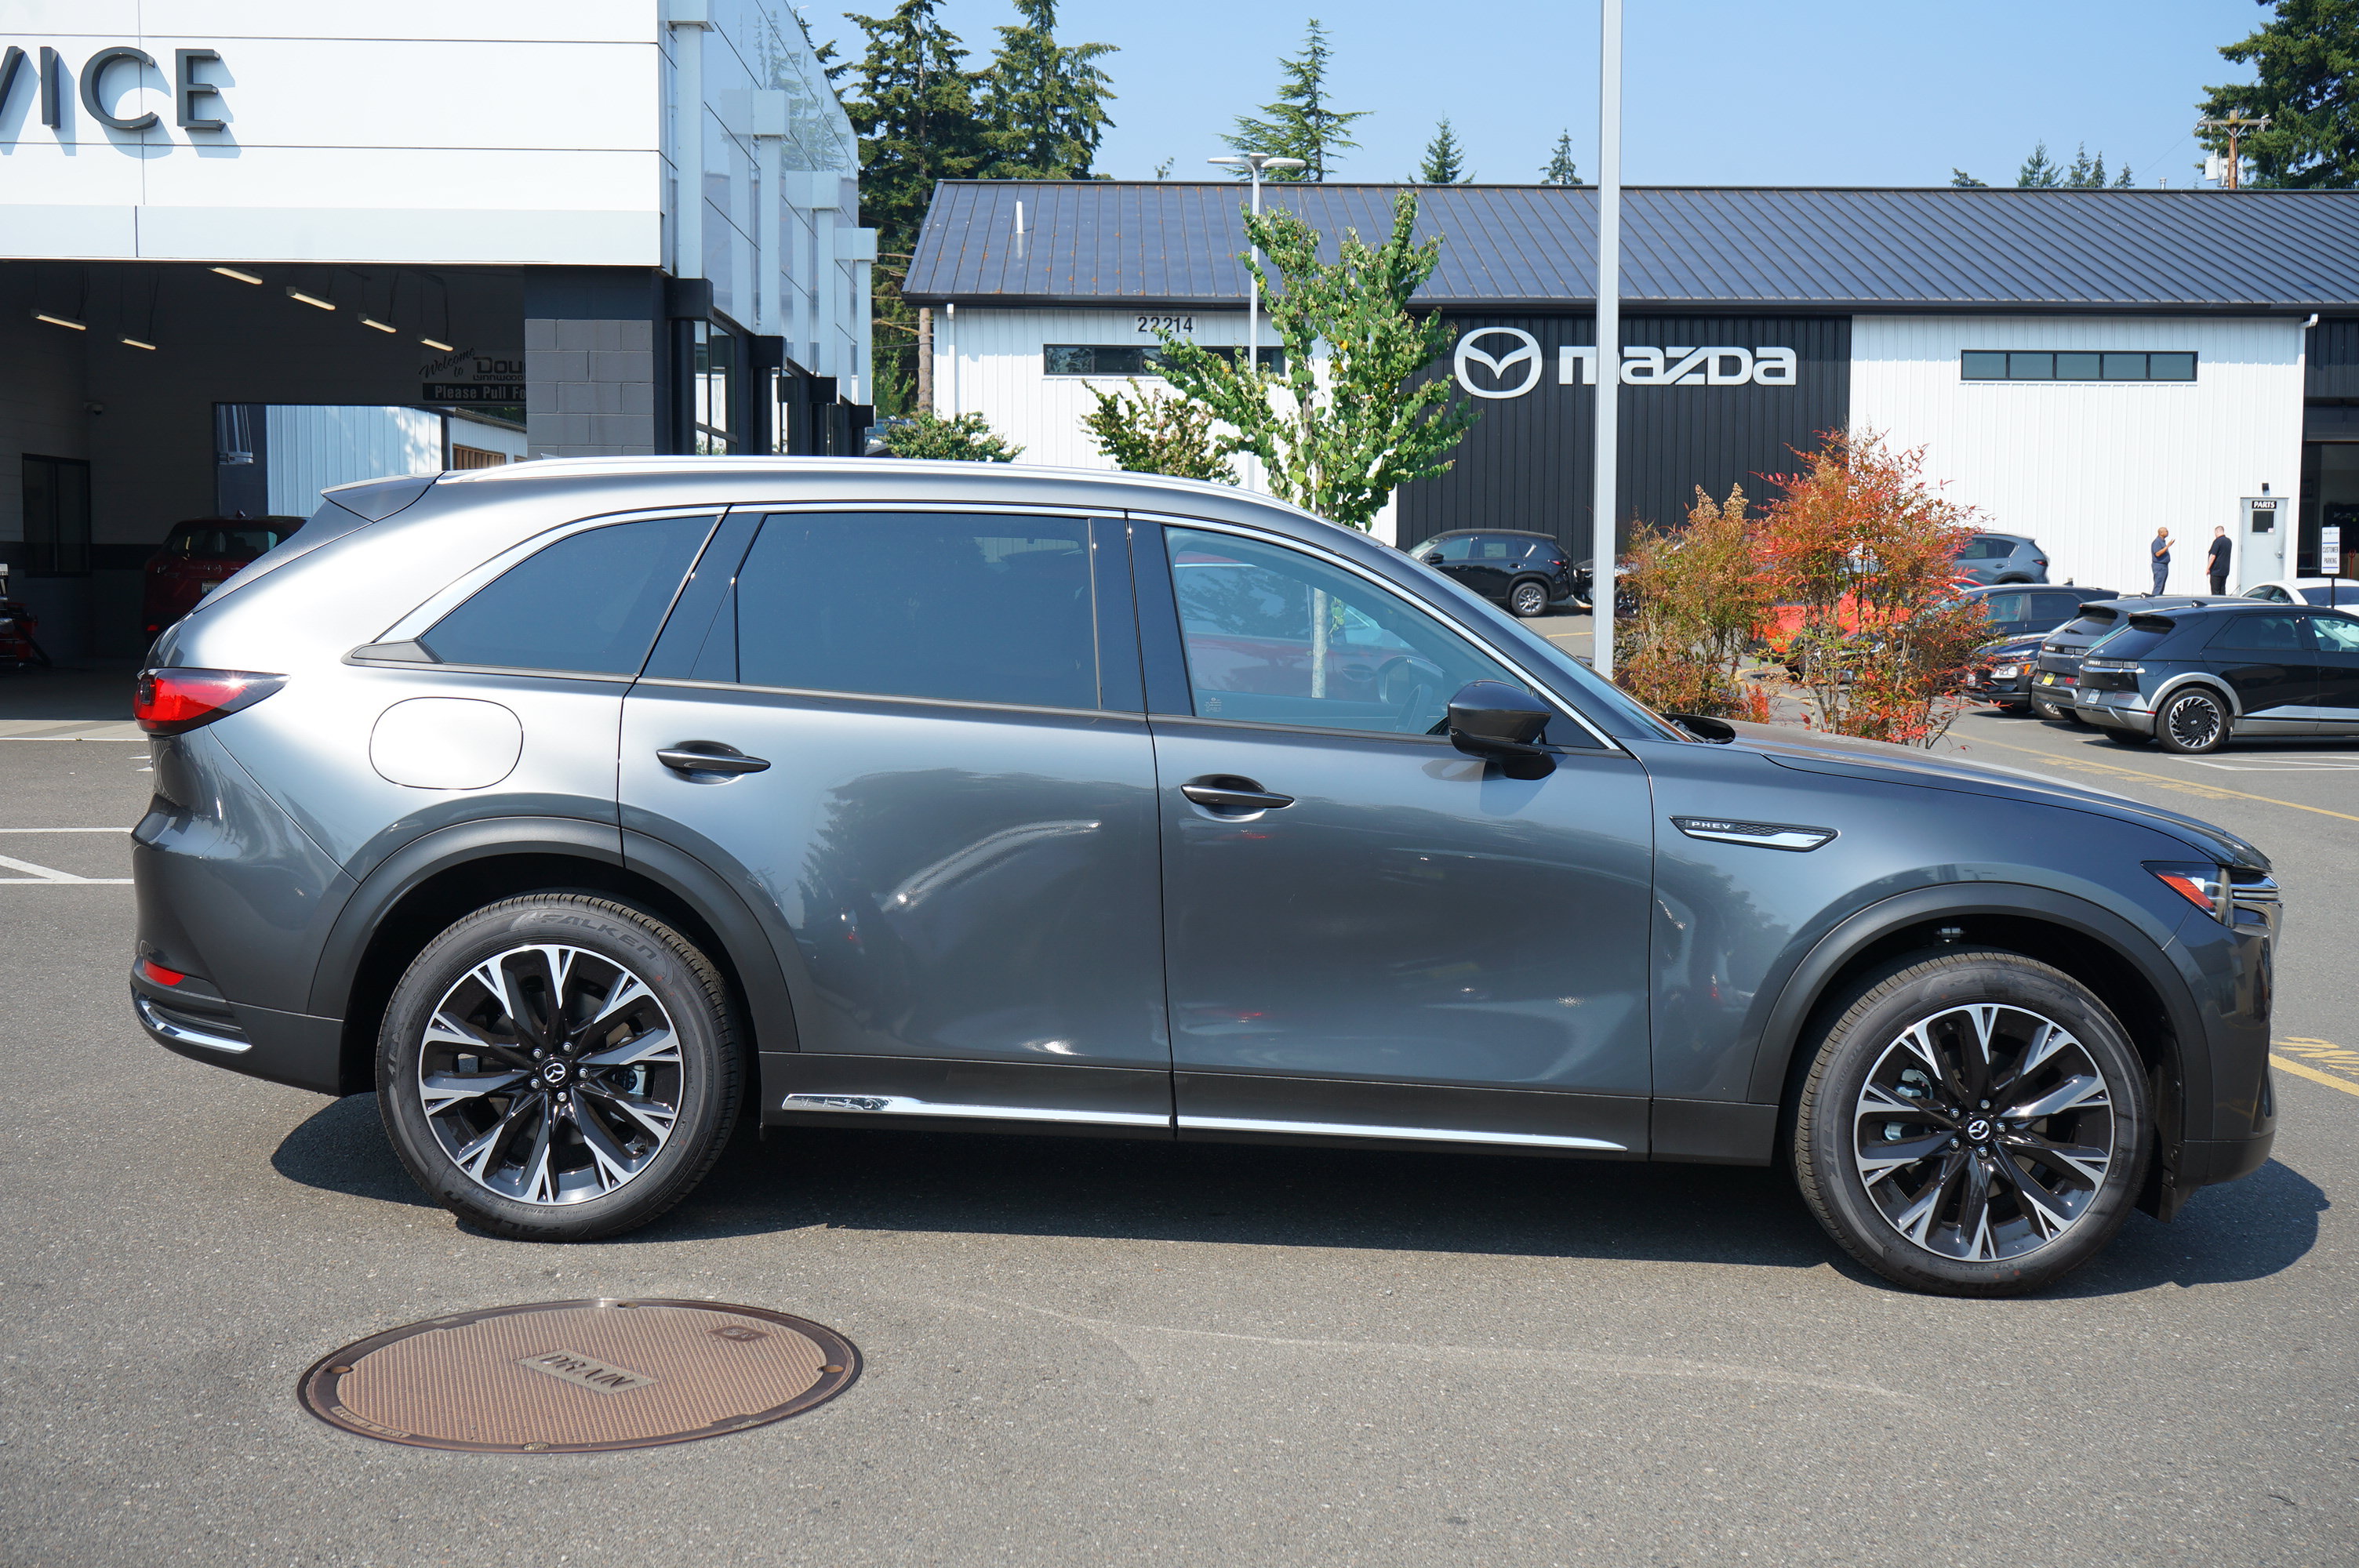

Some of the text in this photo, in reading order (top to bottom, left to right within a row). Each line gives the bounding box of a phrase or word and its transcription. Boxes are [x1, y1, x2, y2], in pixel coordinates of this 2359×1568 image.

[1137, 316, 1194, 333] 22214
[419, 347, 476, 378] Welcome
[434, 385, 477, 399] Please
[482, 386, 507, 400] Pull
[1692, 821, 1731, 829] PHEV
[540, 1354, 636, 1388] DRAIN
